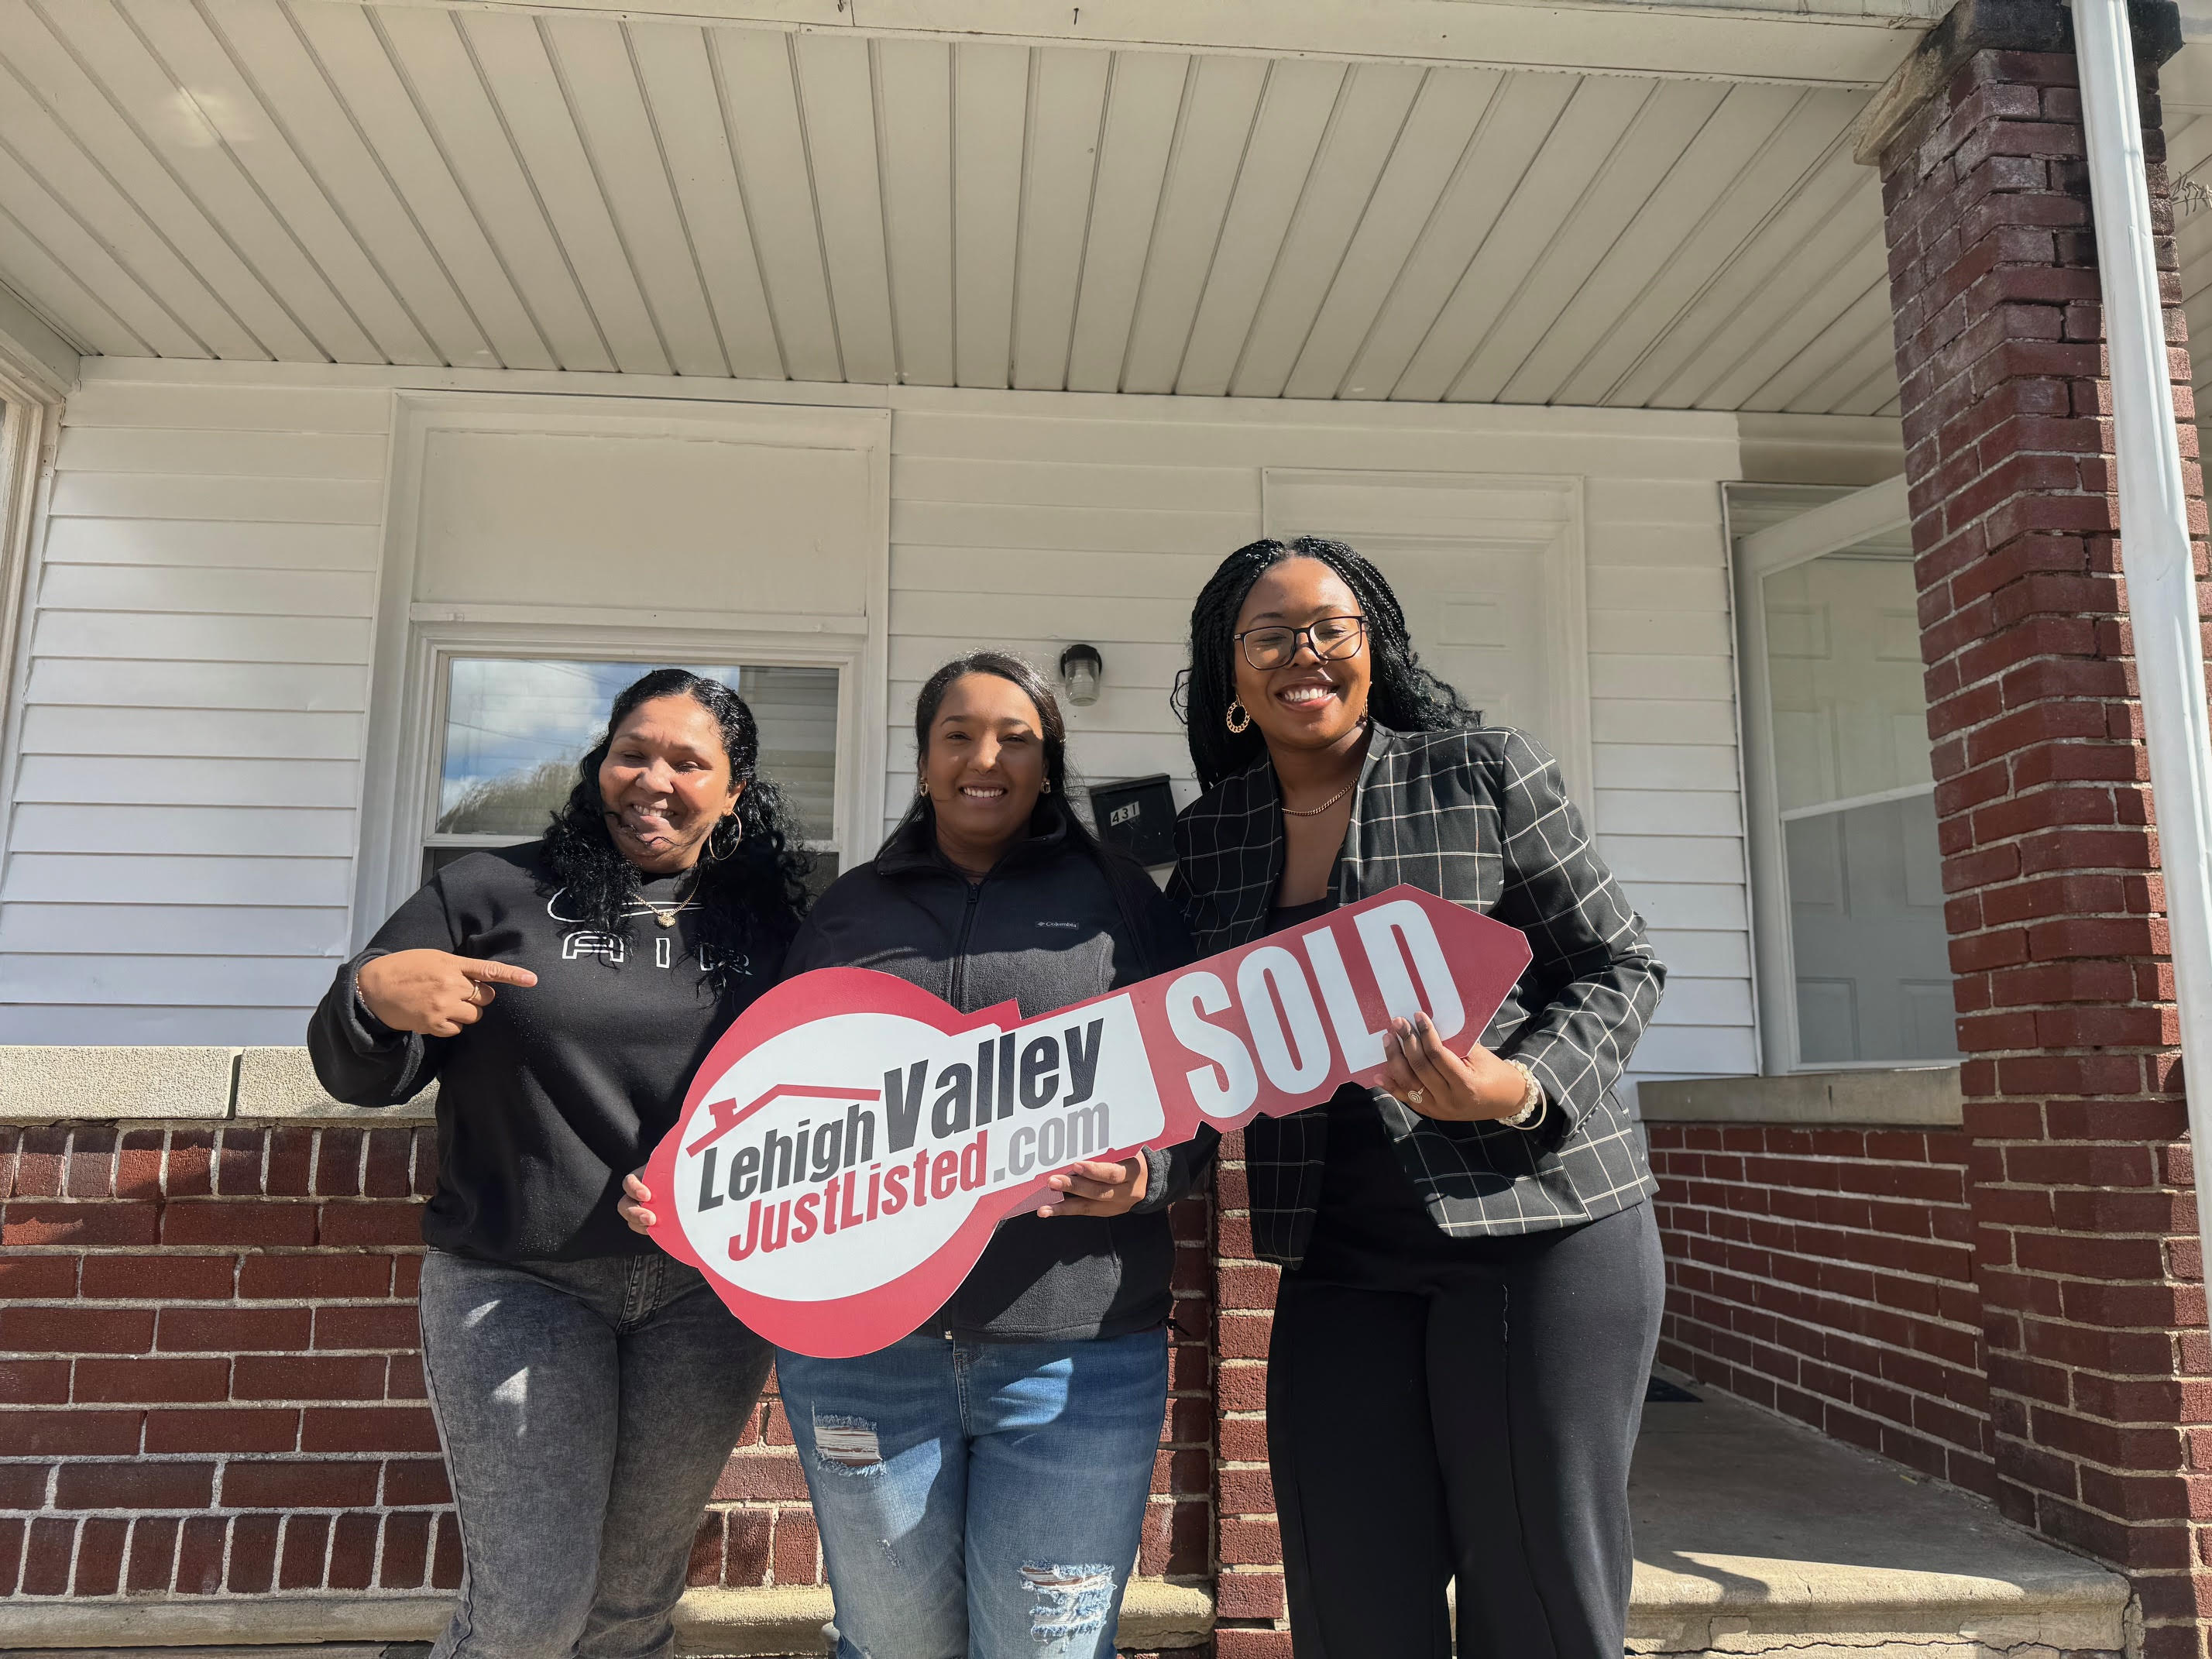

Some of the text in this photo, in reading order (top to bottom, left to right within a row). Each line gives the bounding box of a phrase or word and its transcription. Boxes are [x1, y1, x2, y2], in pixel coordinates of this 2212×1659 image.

[1111, 803, 1137, 823] 431
[1165, 899, 1465, 1118] SOLD
[726, 1101, 1110, 1262] JustListed.com
